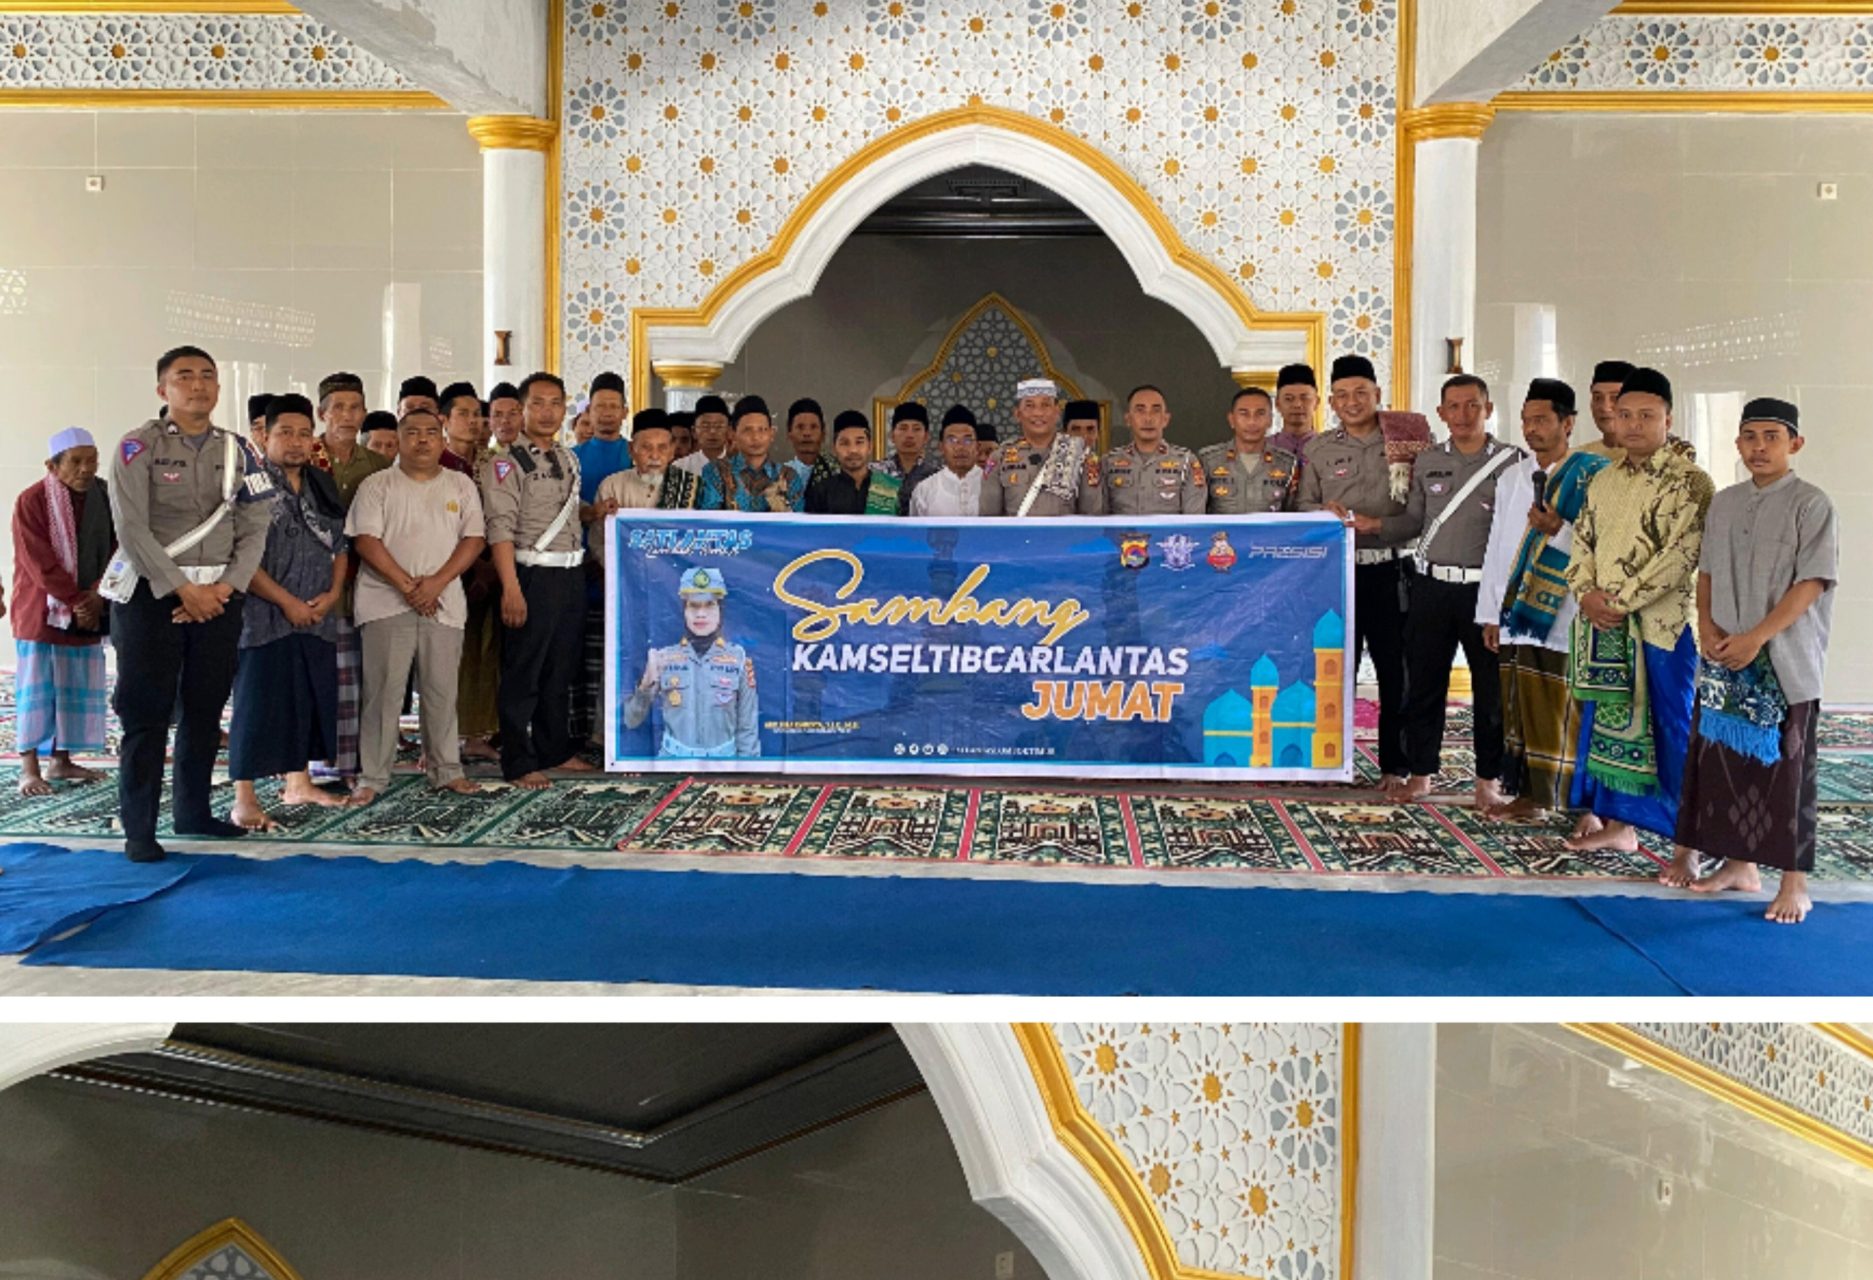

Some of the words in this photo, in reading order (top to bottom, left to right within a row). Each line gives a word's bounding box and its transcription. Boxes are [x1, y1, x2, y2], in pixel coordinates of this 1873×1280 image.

[773, 549, 1088, 645] Sambang
[792, 644, 1188, 676] KAMSELTIBCARLANTAS
[1021, 682, 1183, 722] JUMAT
